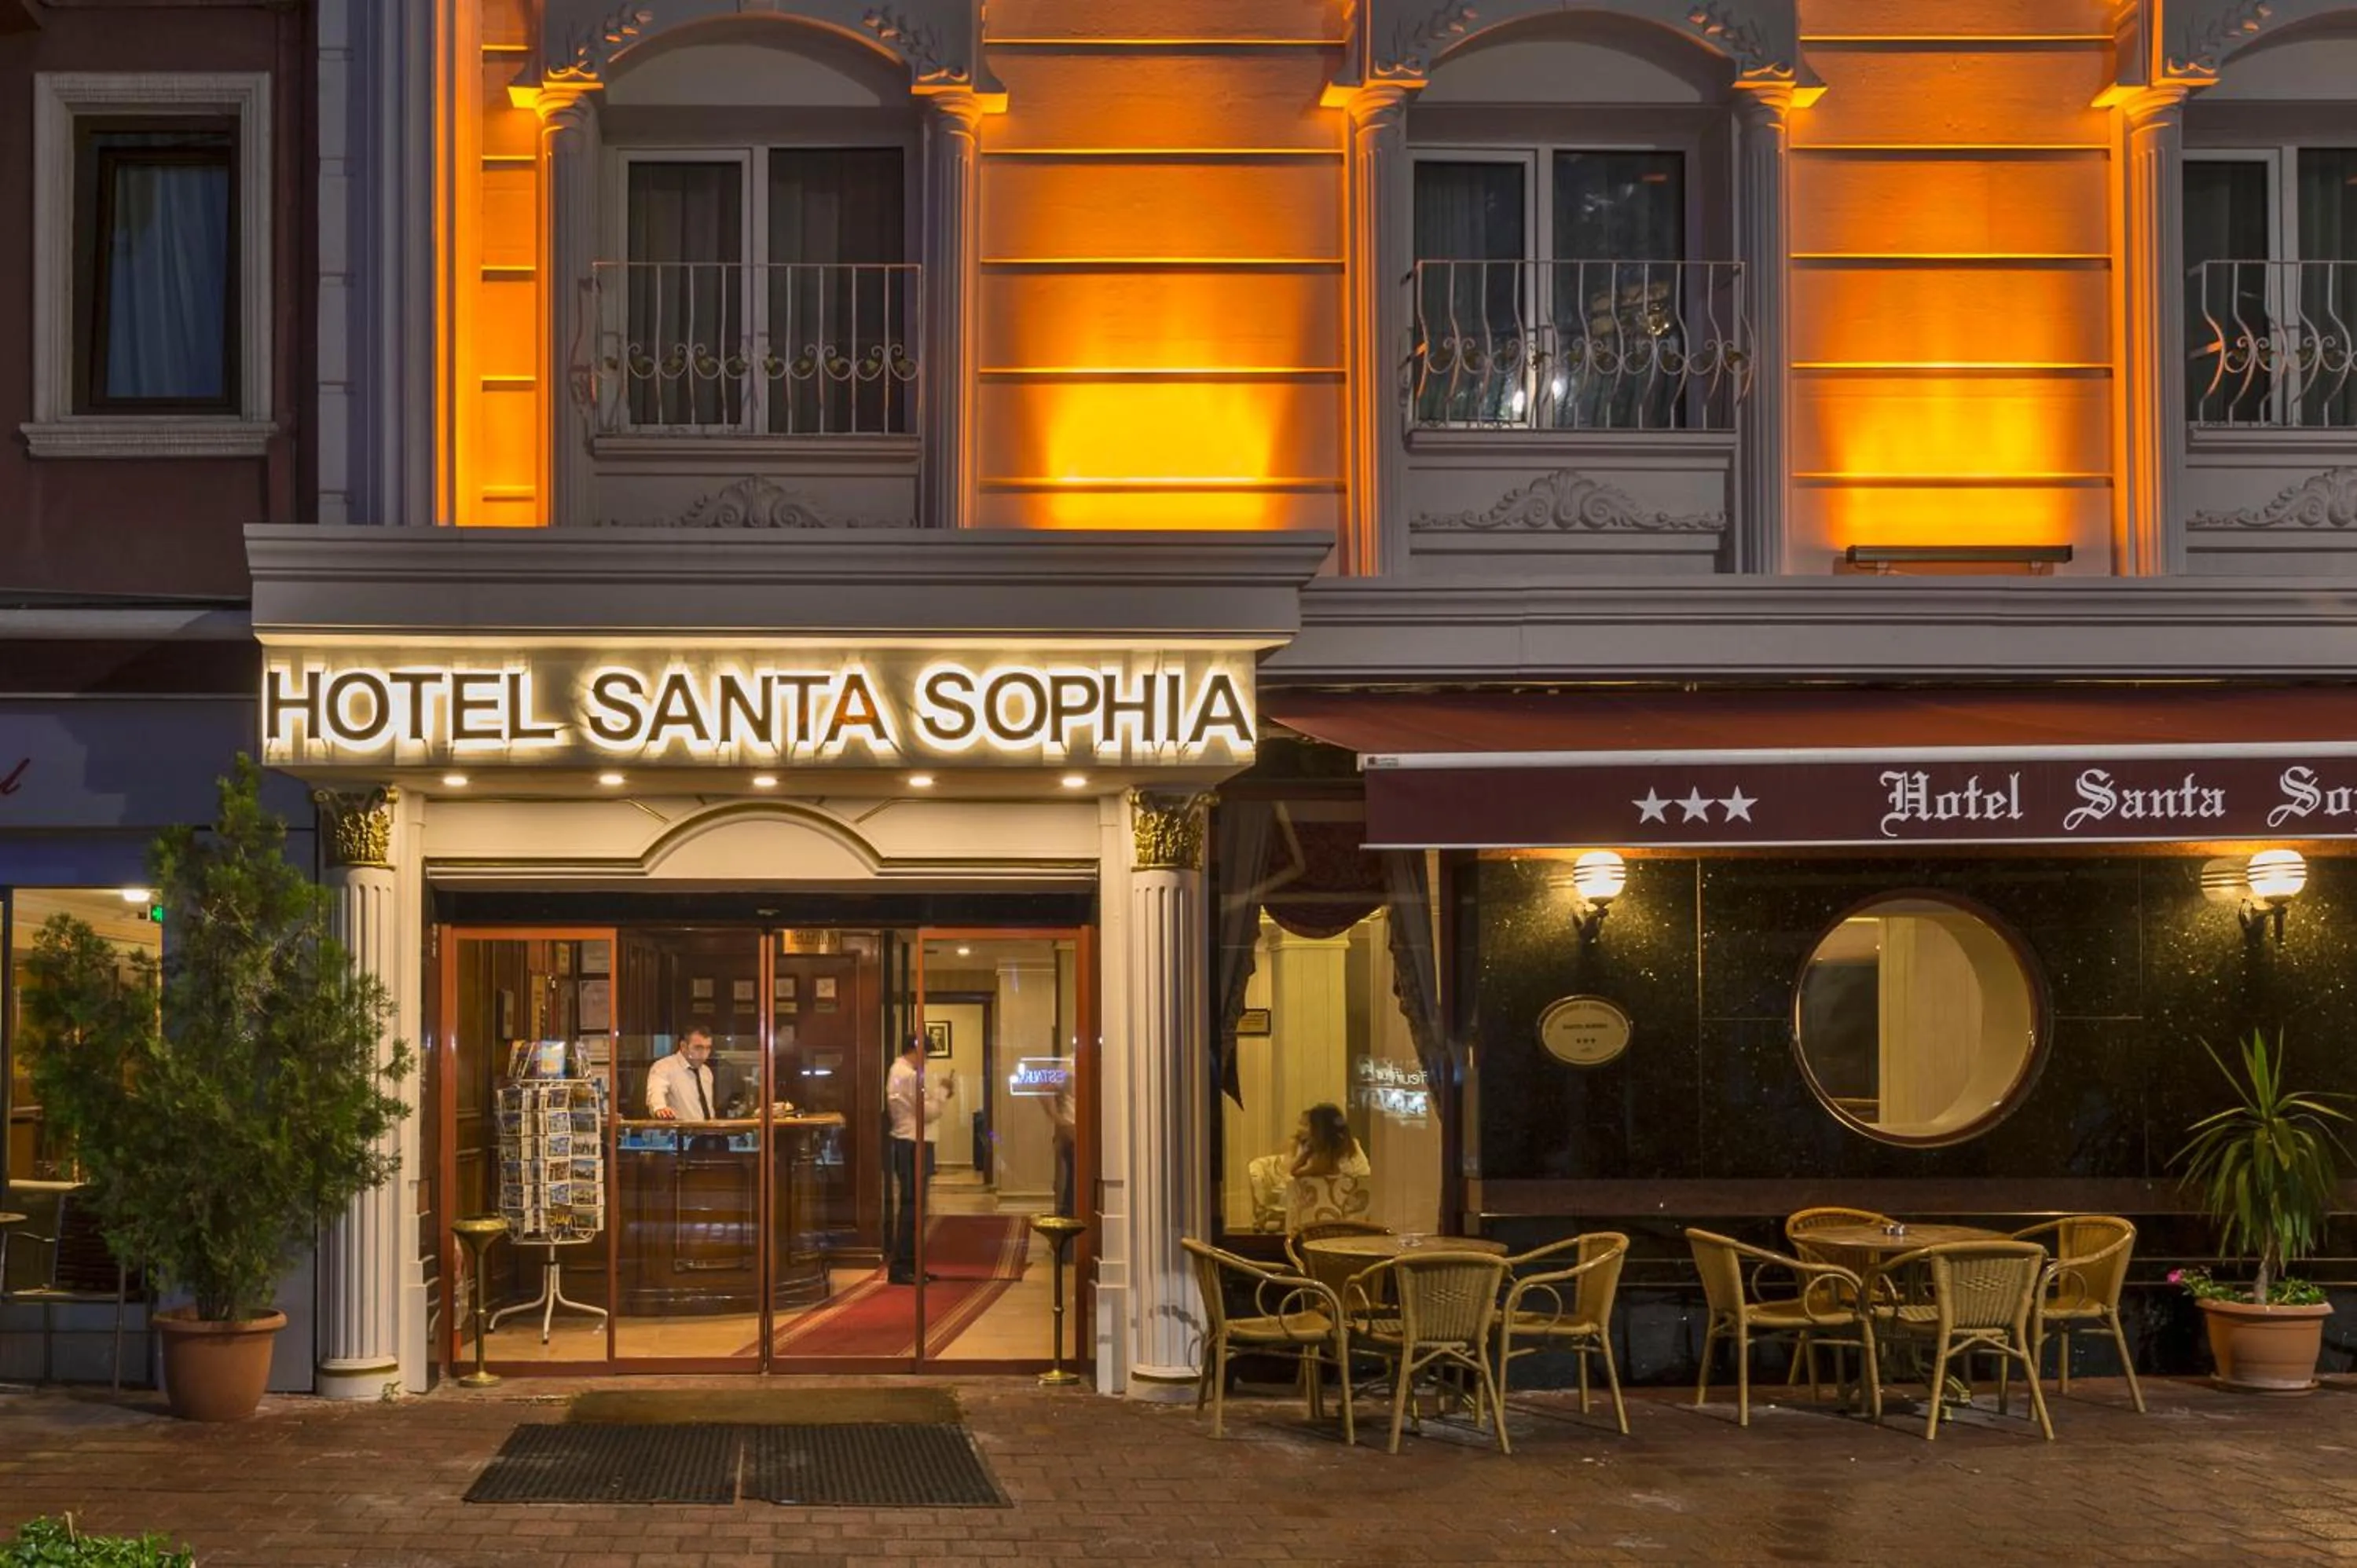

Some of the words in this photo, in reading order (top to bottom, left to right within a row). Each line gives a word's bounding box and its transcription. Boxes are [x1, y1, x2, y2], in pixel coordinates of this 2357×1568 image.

[266, 671, 555, 742] HOTEL
[588, 672, 889, 743] SANTA
[922, 671, 1255, 741] SOPHIA
[1880, 770, 2024, 837] Hotel
[2062, 768, 2226, 830] Santa
[2266, 765, 2357, 832] So
